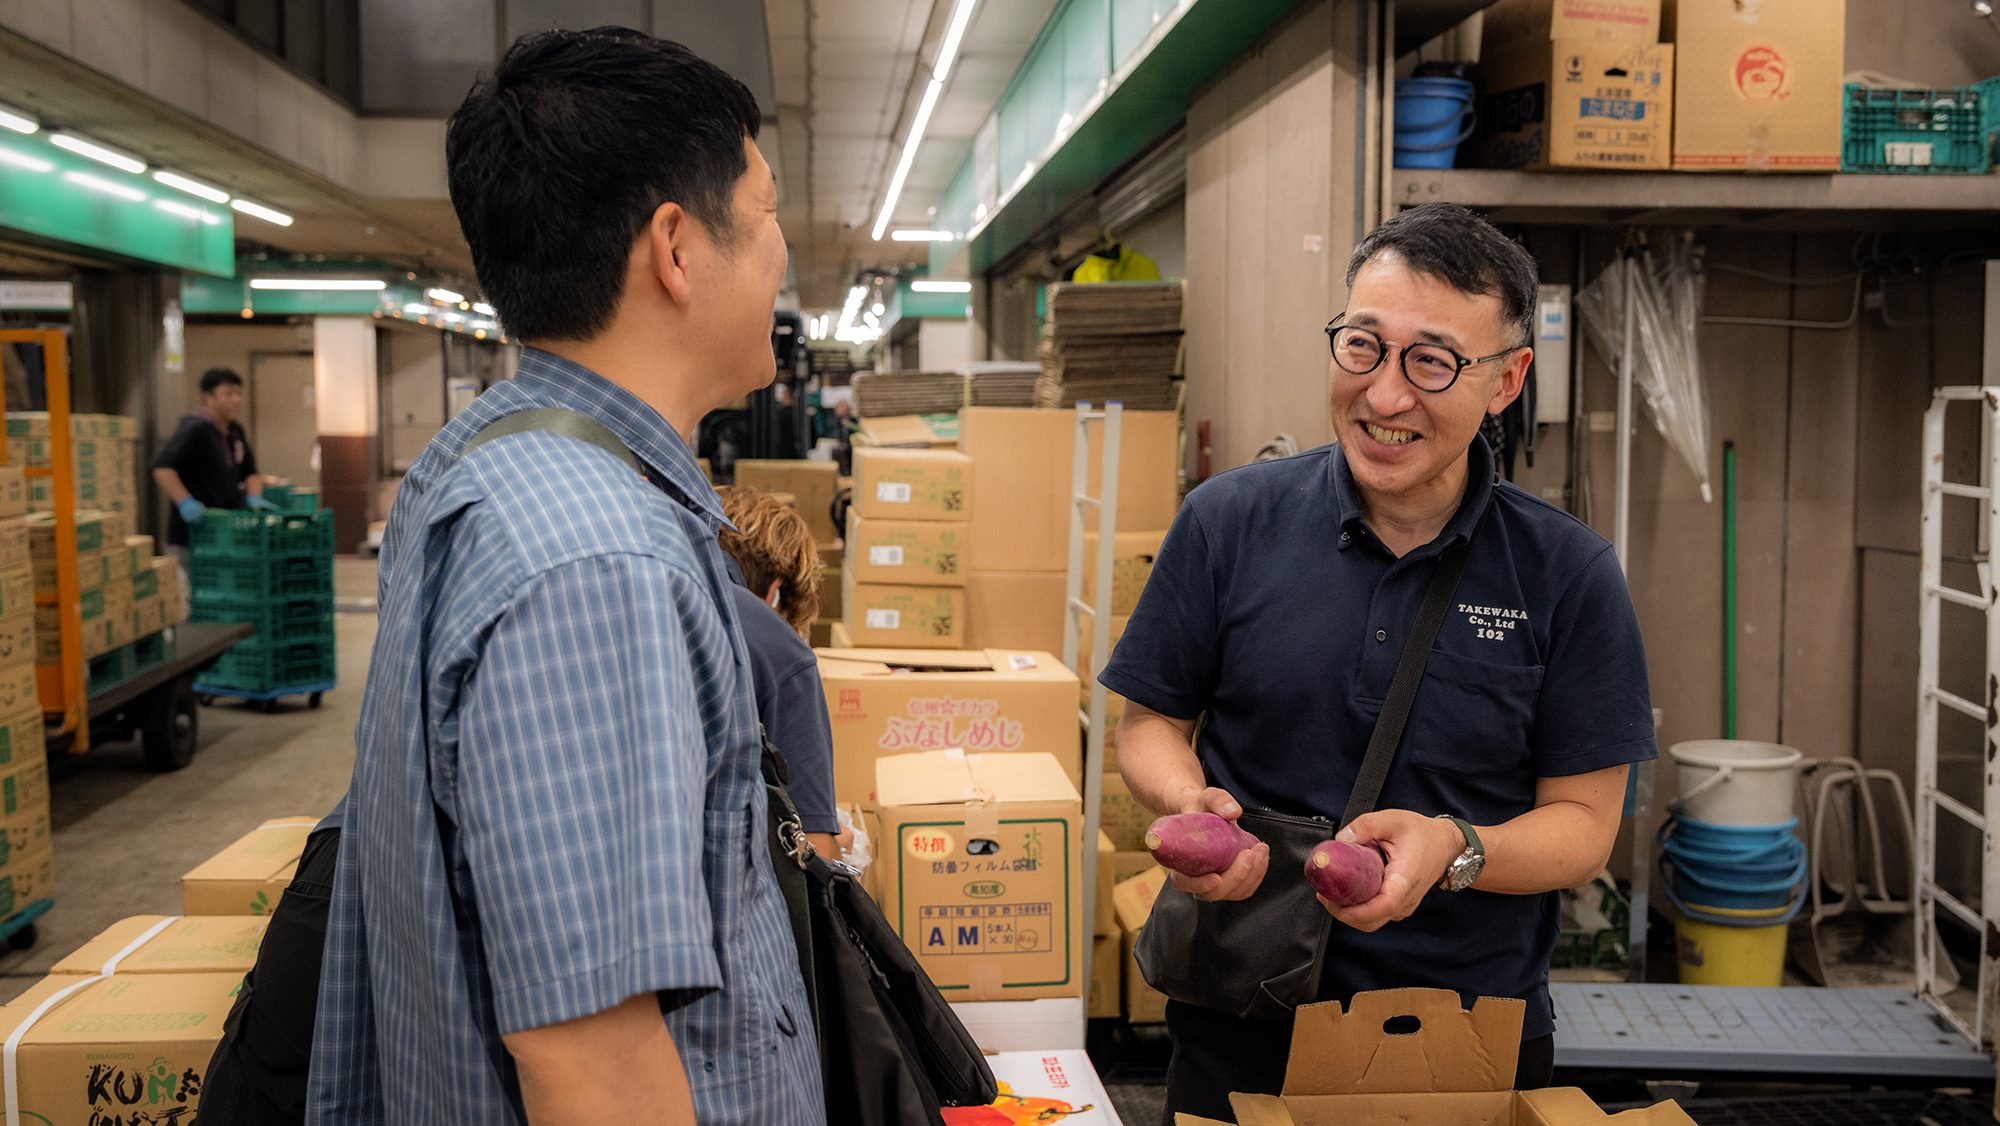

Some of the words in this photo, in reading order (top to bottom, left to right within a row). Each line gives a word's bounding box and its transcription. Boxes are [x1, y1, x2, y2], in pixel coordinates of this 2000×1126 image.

[1458, 604, 1528, 620] TAKEWAKA
[1469, 616, 1491, 627] Co.,
[1495, 619, 1516, 629] Ltd
[1477, 629, 1504, 641] 102
[880, 719, 1023, 748] ぶなしめじ
[928, 926, 945, 946] A
[958, 926, 979, 946] M
